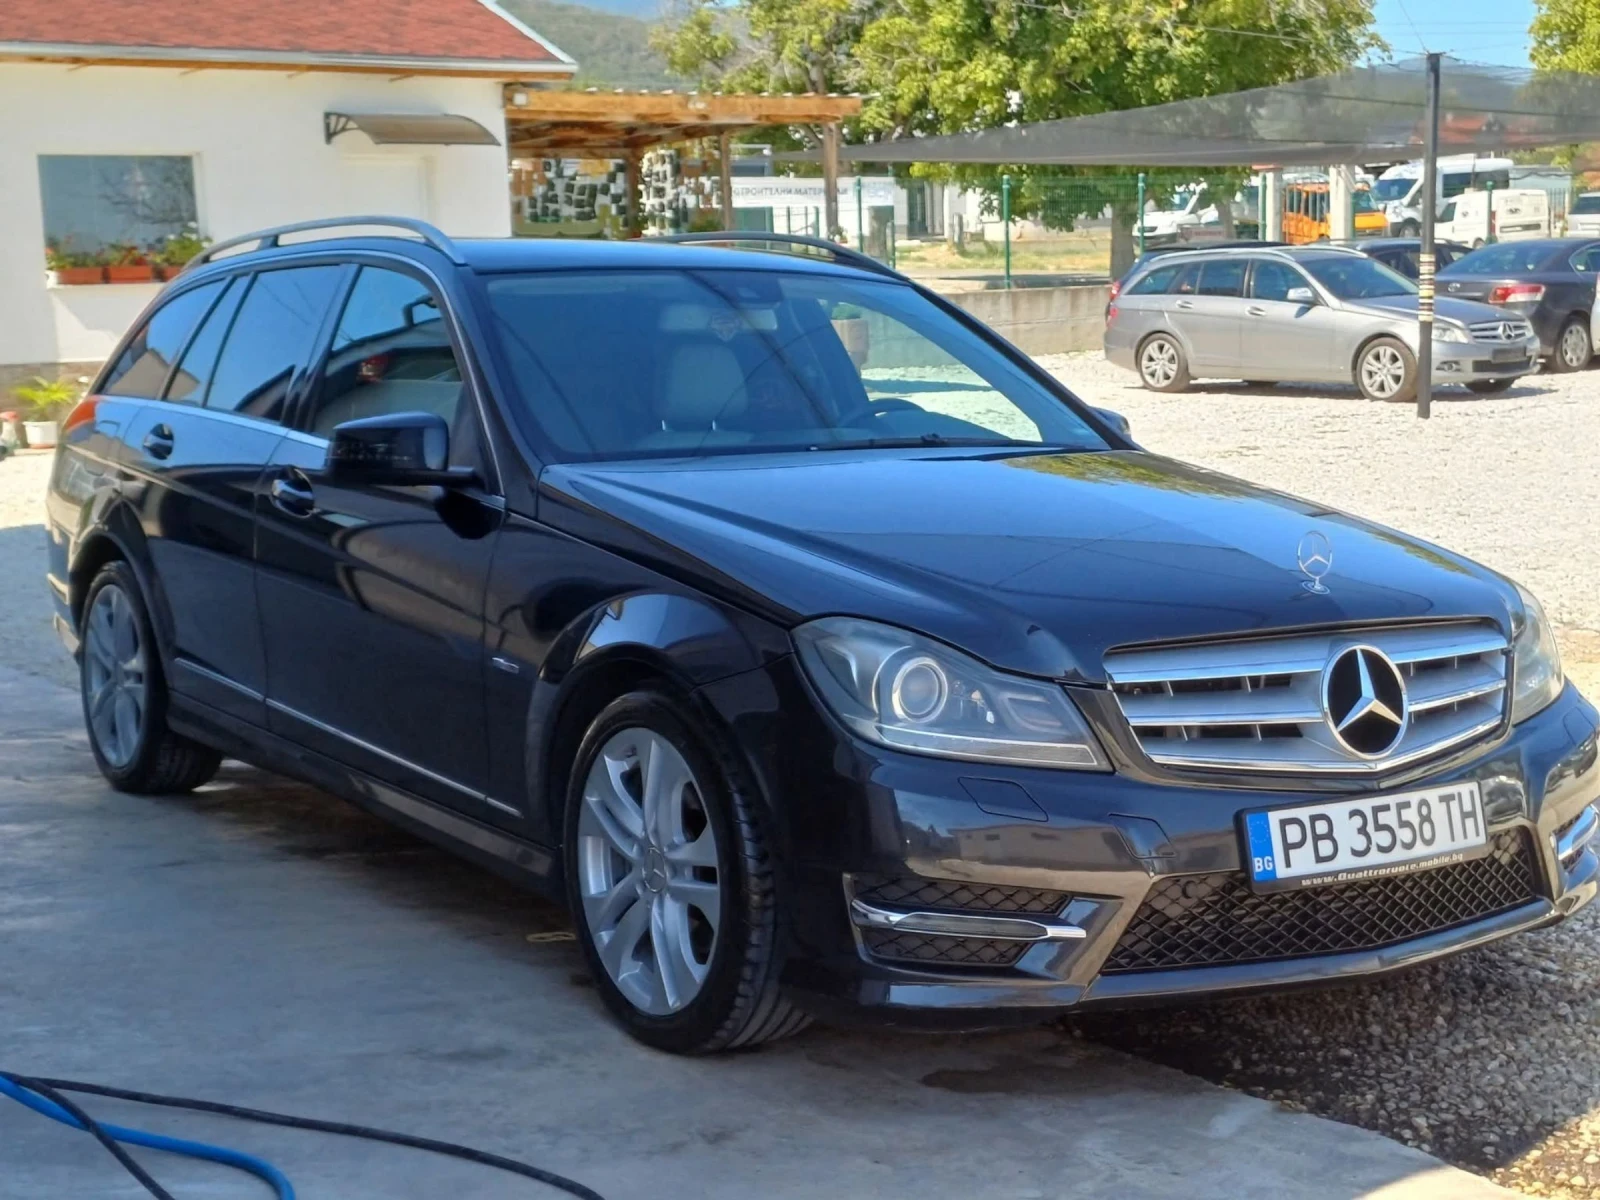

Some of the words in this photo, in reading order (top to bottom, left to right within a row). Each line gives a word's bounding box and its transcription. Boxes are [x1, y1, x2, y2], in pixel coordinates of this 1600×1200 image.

[1279, 813, 1339, 869] PB
[1348, 798, 1437, 858] 3558
[1438, 789, 1481, 843] TH
[1253, 856, 1274, 873] BG
